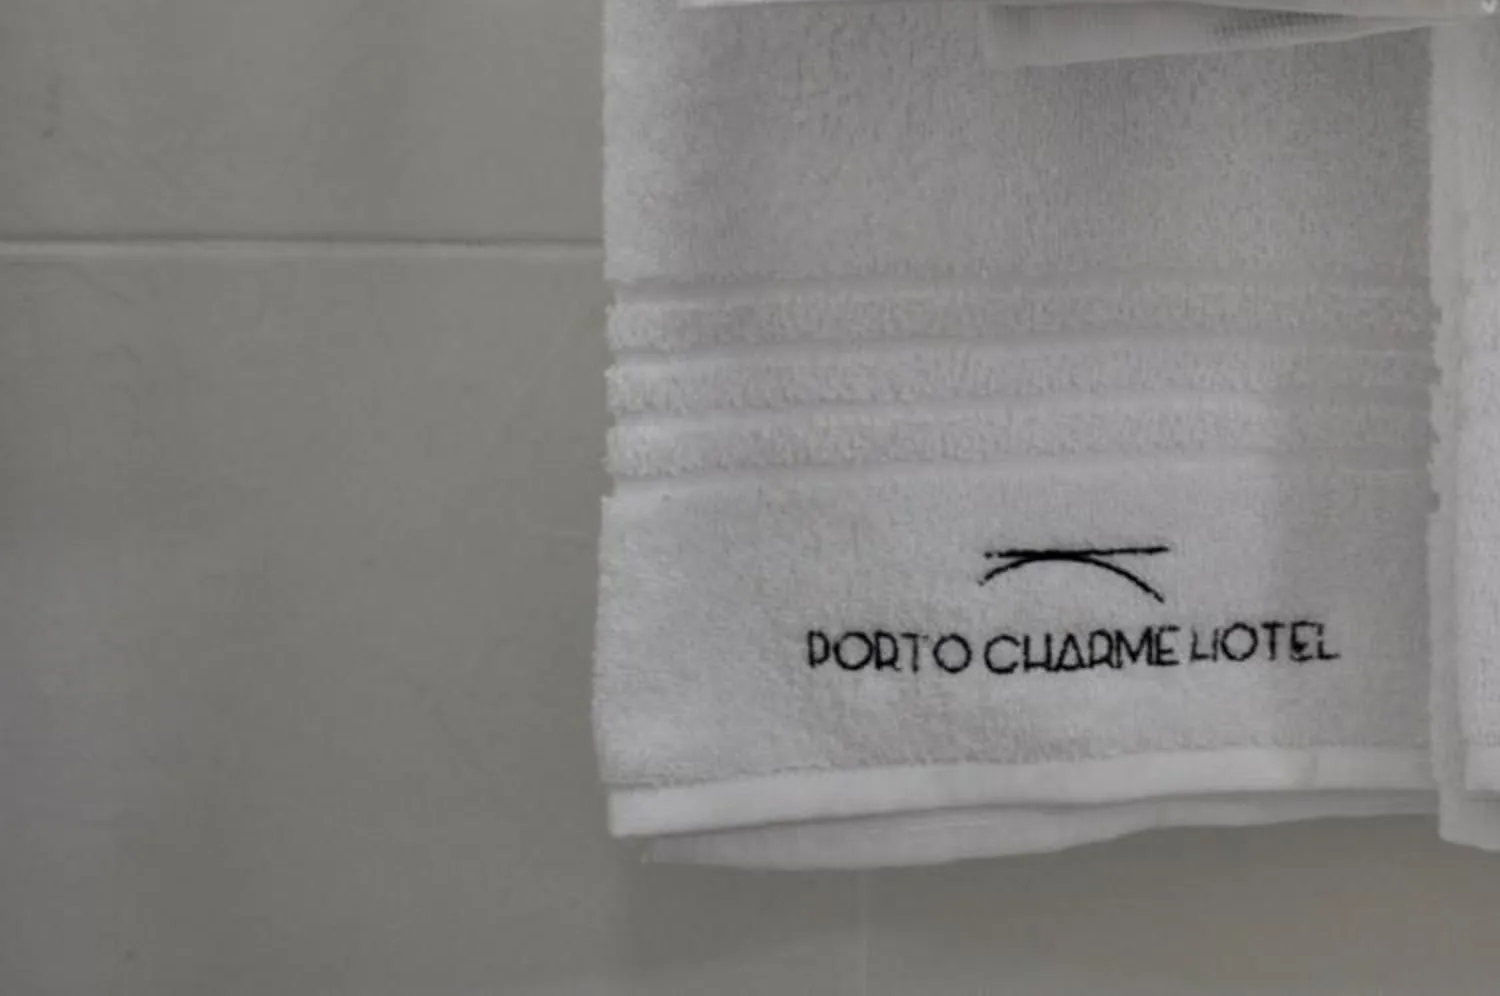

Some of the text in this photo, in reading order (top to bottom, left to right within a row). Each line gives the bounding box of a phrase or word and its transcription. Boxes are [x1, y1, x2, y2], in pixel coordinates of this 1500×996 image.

[806, 620, 1340, 675] PORTO CHARME HOTEL
